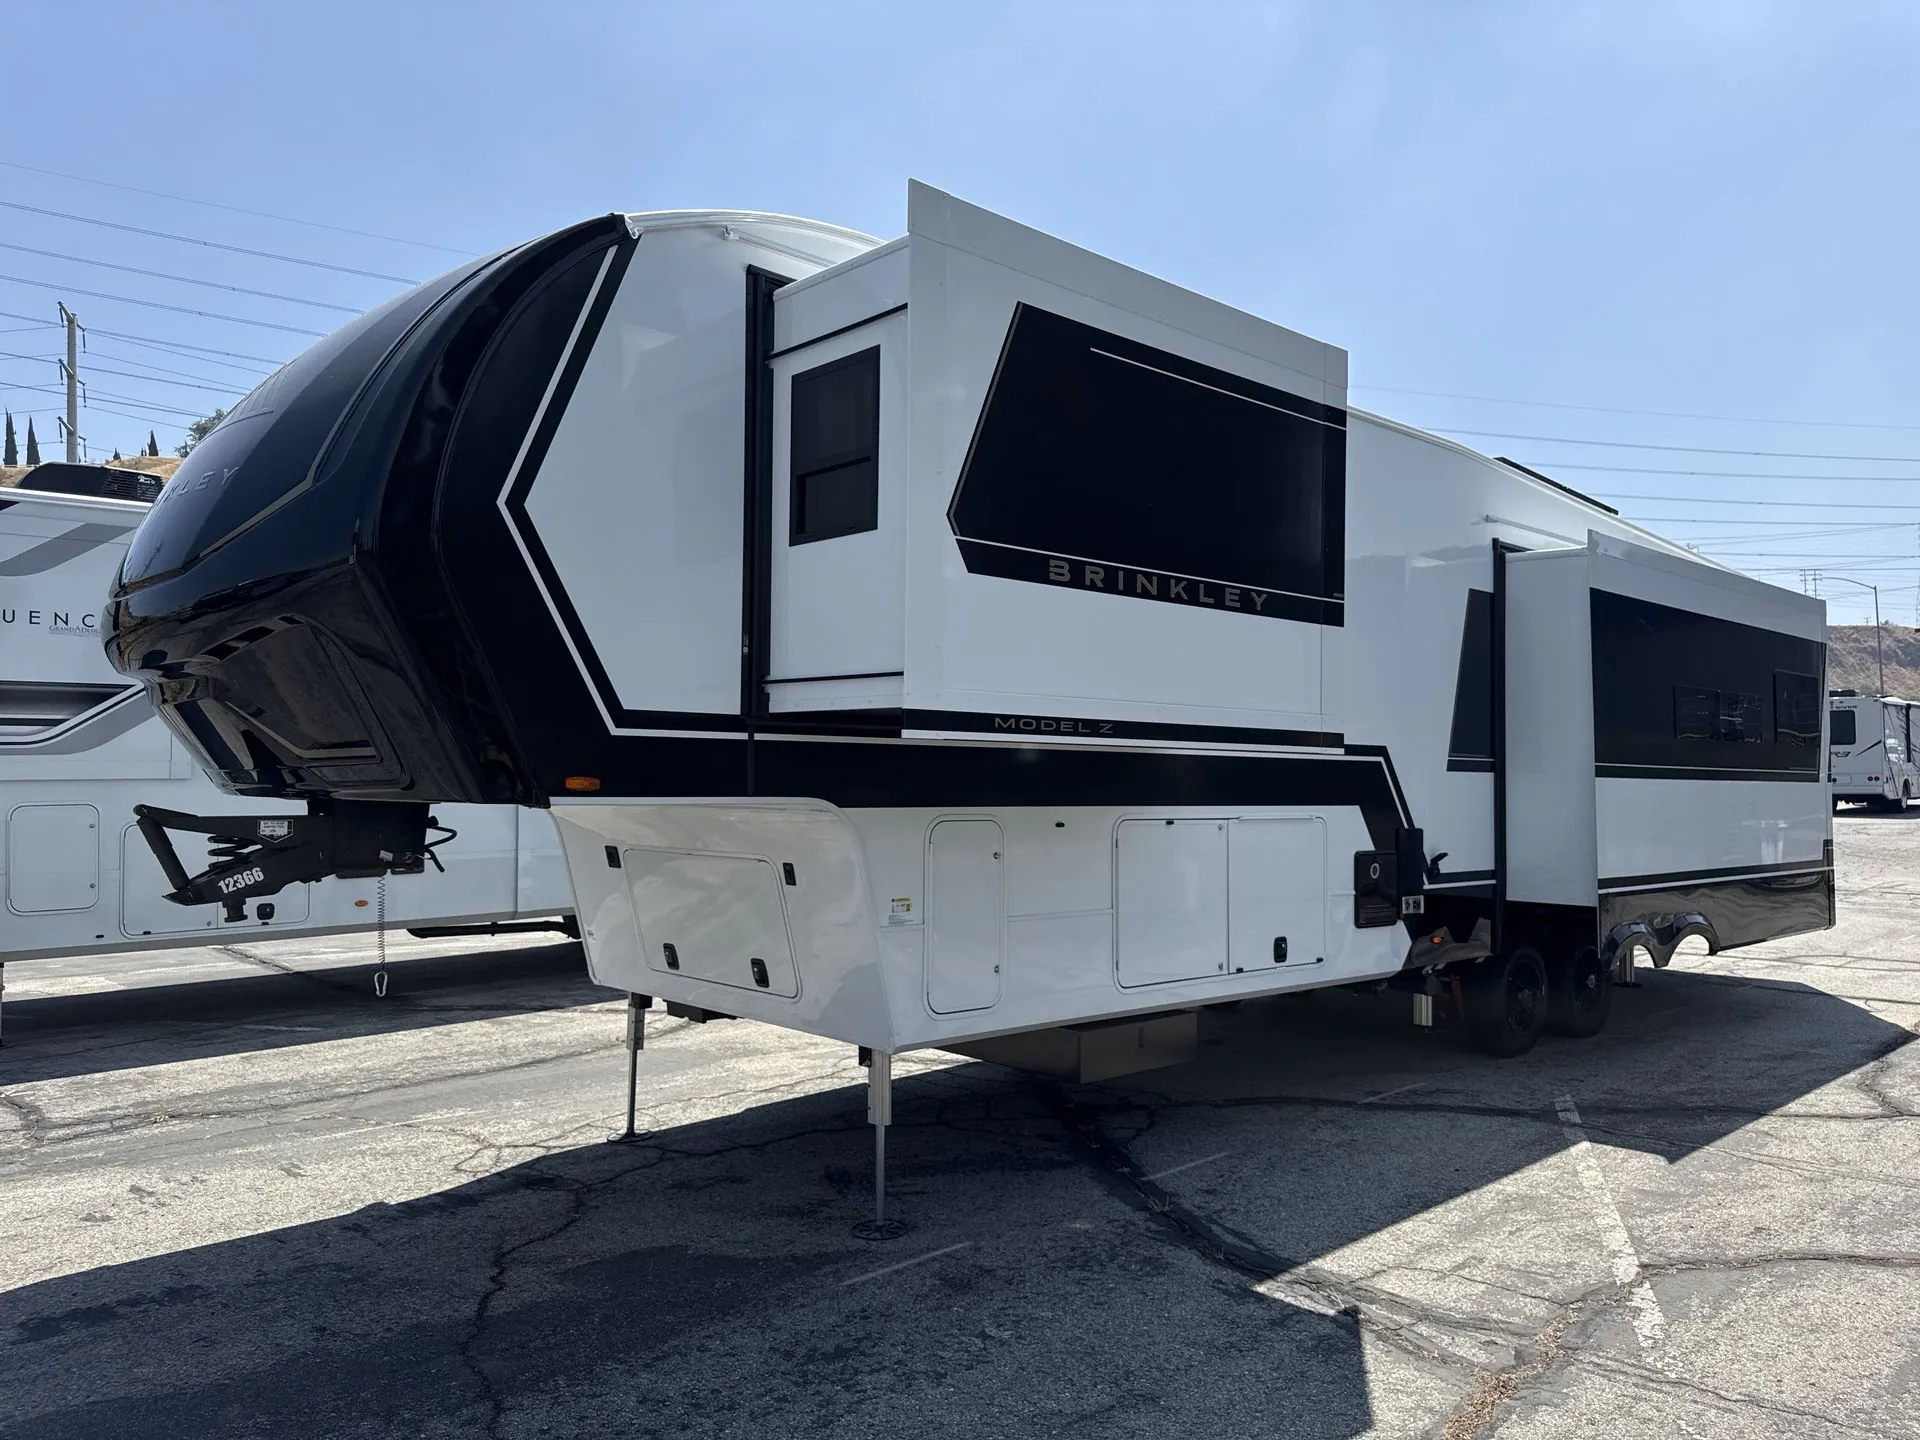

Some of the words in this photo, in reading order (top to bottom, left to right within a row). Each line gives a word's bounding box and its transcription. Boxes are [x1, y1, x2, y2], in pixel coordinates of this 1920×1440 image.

[1049, 559, 1268, 611] BRINKLEY
[2, 608, 95, 629] UENC
[994, 717, 1091, 732] MODEL
[1099, 723, 1114, 734] Z
[217, 866, 265, 894] 12366
